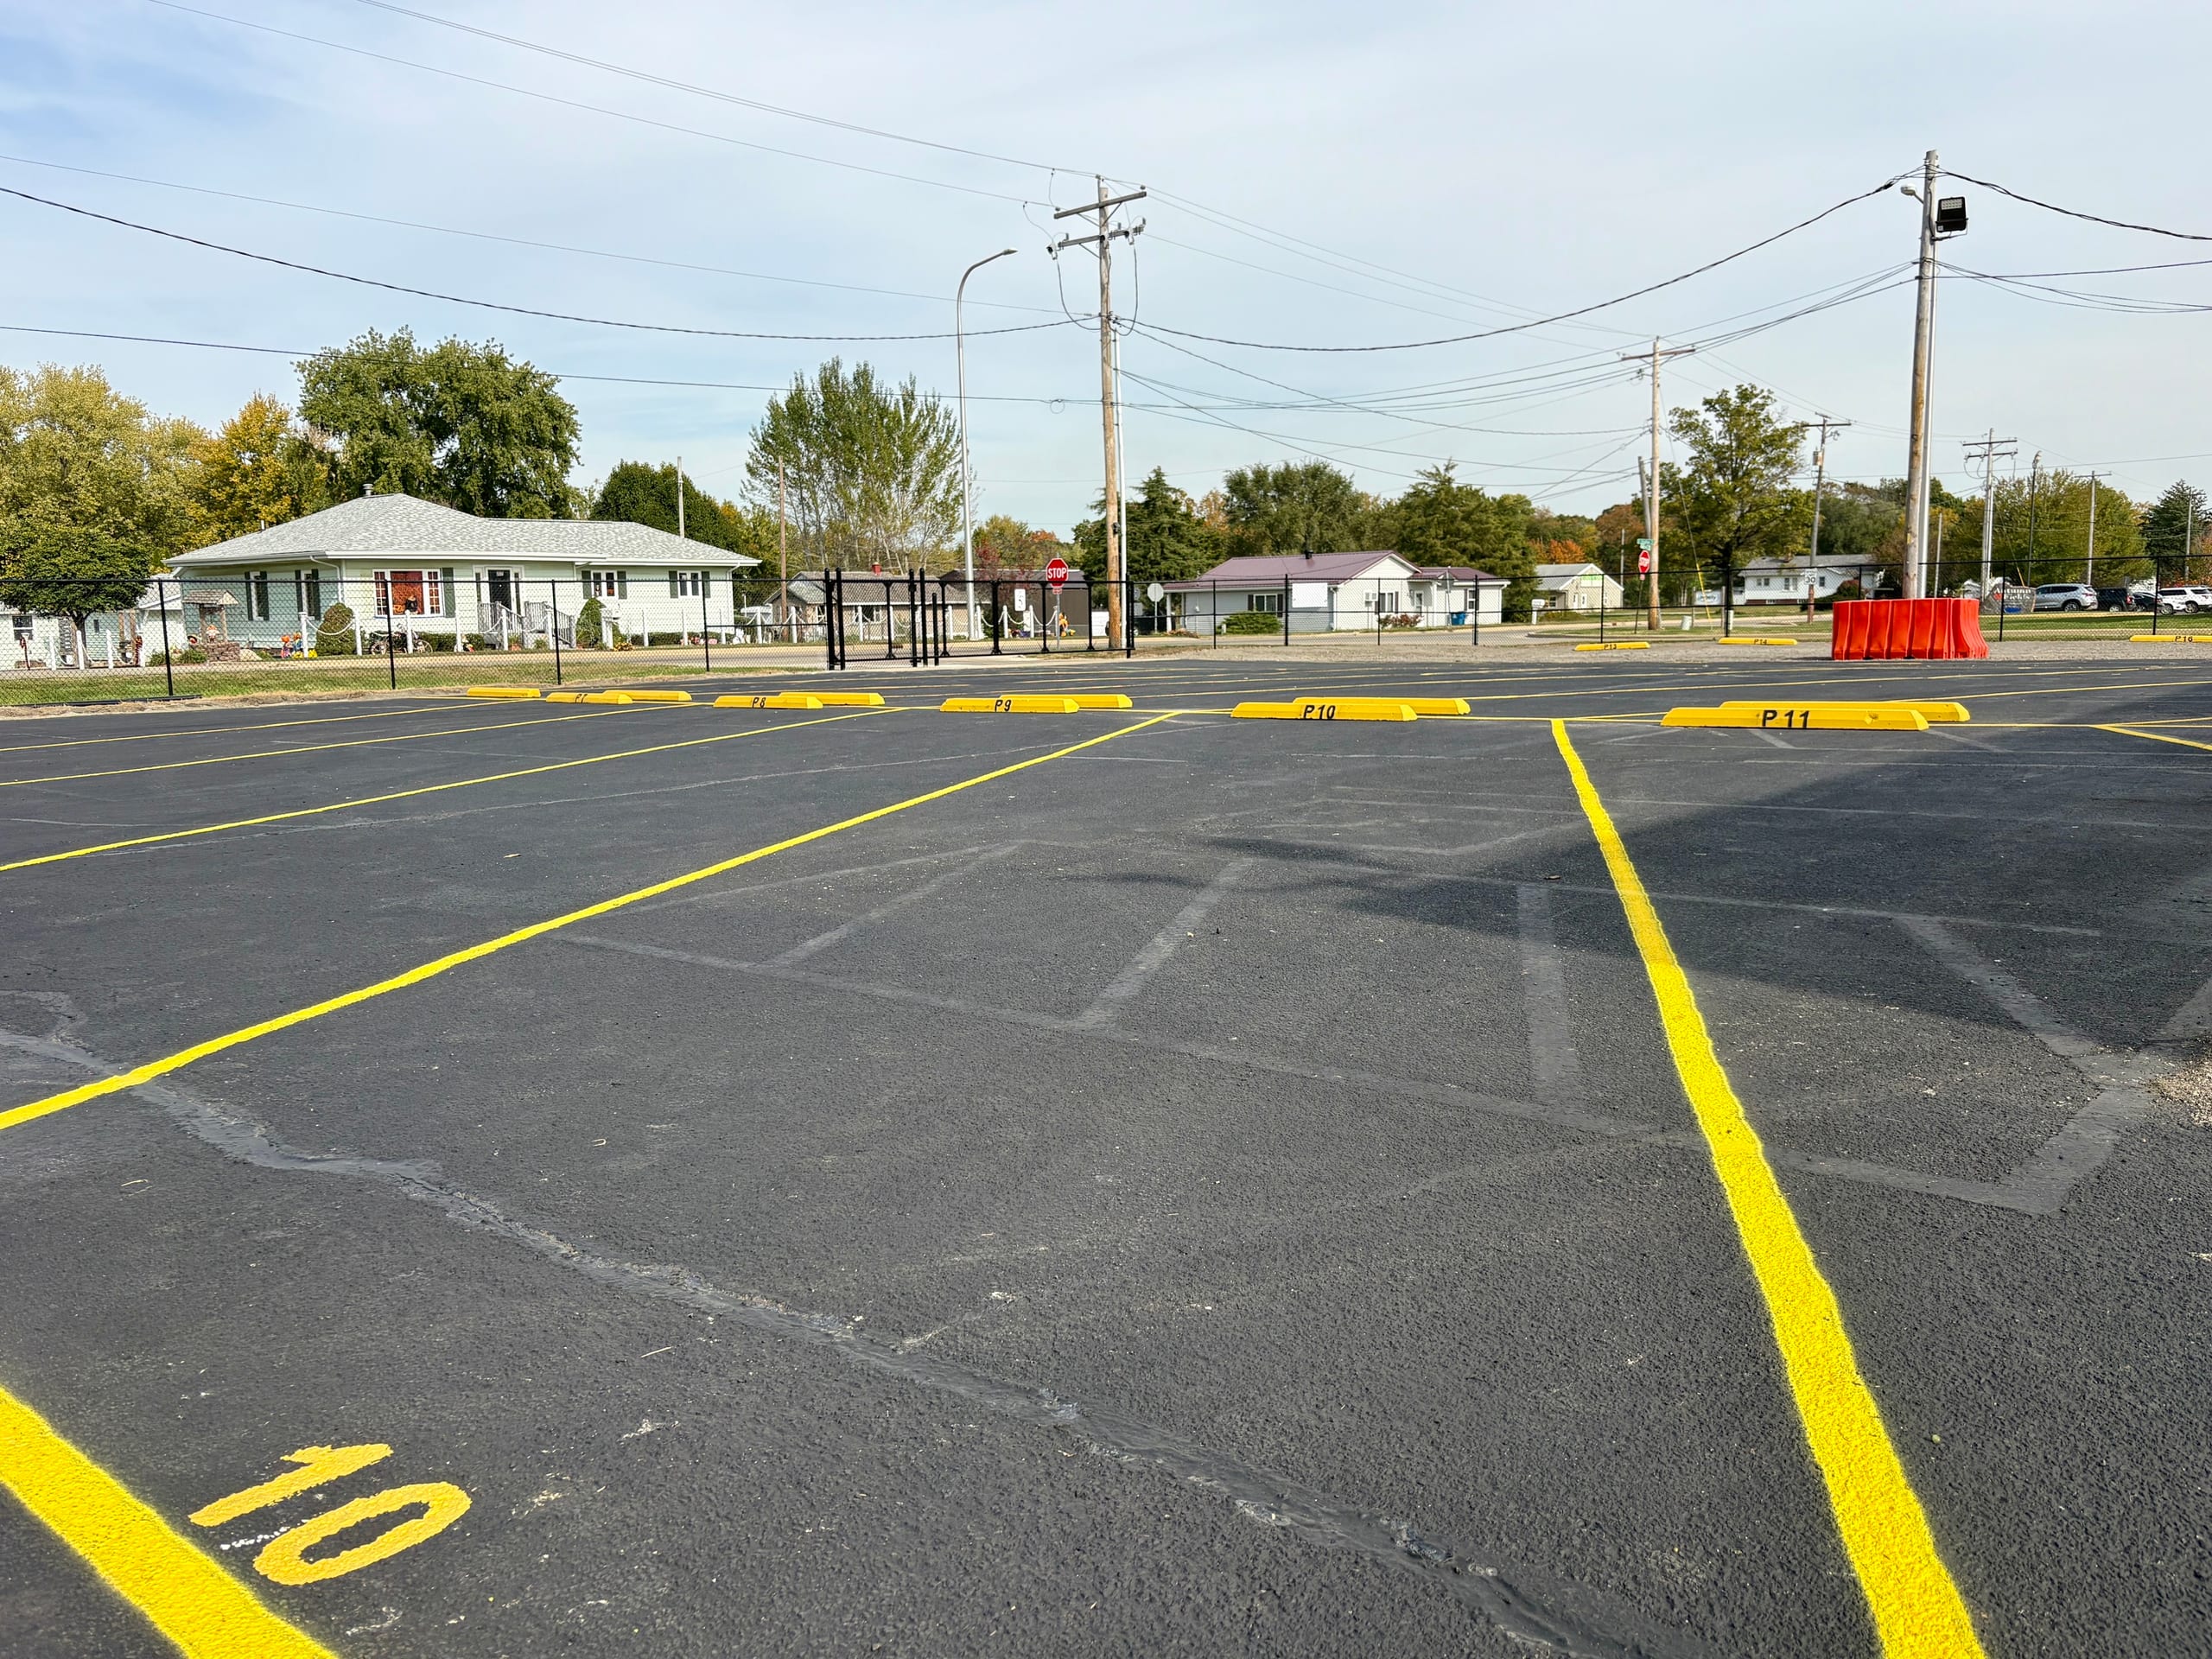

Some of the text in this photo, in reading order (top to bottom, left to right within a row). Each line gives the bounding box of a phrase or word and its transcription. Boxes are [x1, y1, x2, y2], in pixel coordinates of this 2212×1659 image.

[1048, 568, 1066, 579] STOP
[575, 693, 588, 704] P7
[753, 696, 766, 709] P8
[995, 699, 1012, 712] P9
[1303, 704, 1336, 720] P10
[1762, 709, 1809, 728] P11
[188, 1443, 473, 1586] 10
